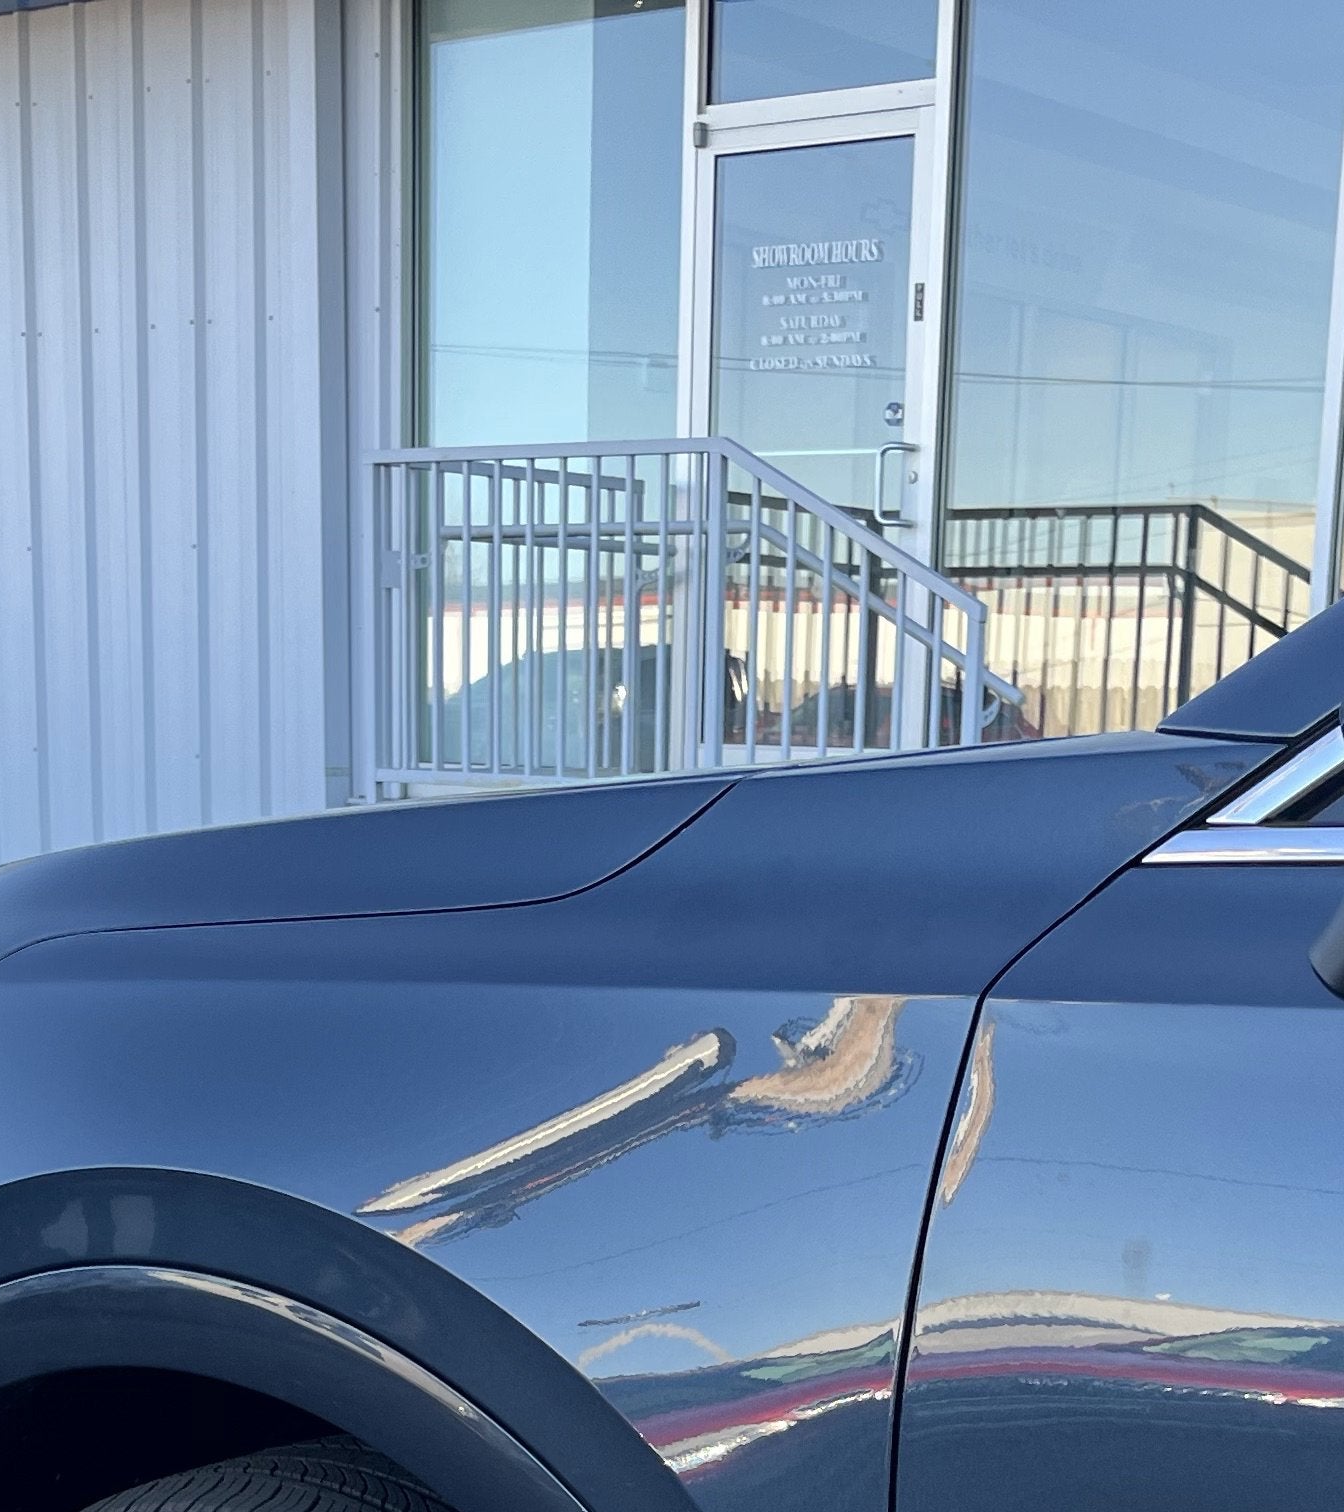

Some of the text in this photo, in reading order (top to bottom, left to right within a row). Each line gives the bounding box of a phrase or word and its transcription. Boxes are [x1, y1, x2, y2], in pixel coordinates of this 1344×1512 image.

[752, 239, 880, 268] SHOWROOM HOURS
[780, 314, 841, 330] SATURDAY
[749, 357, 798, 370] CLOSED
